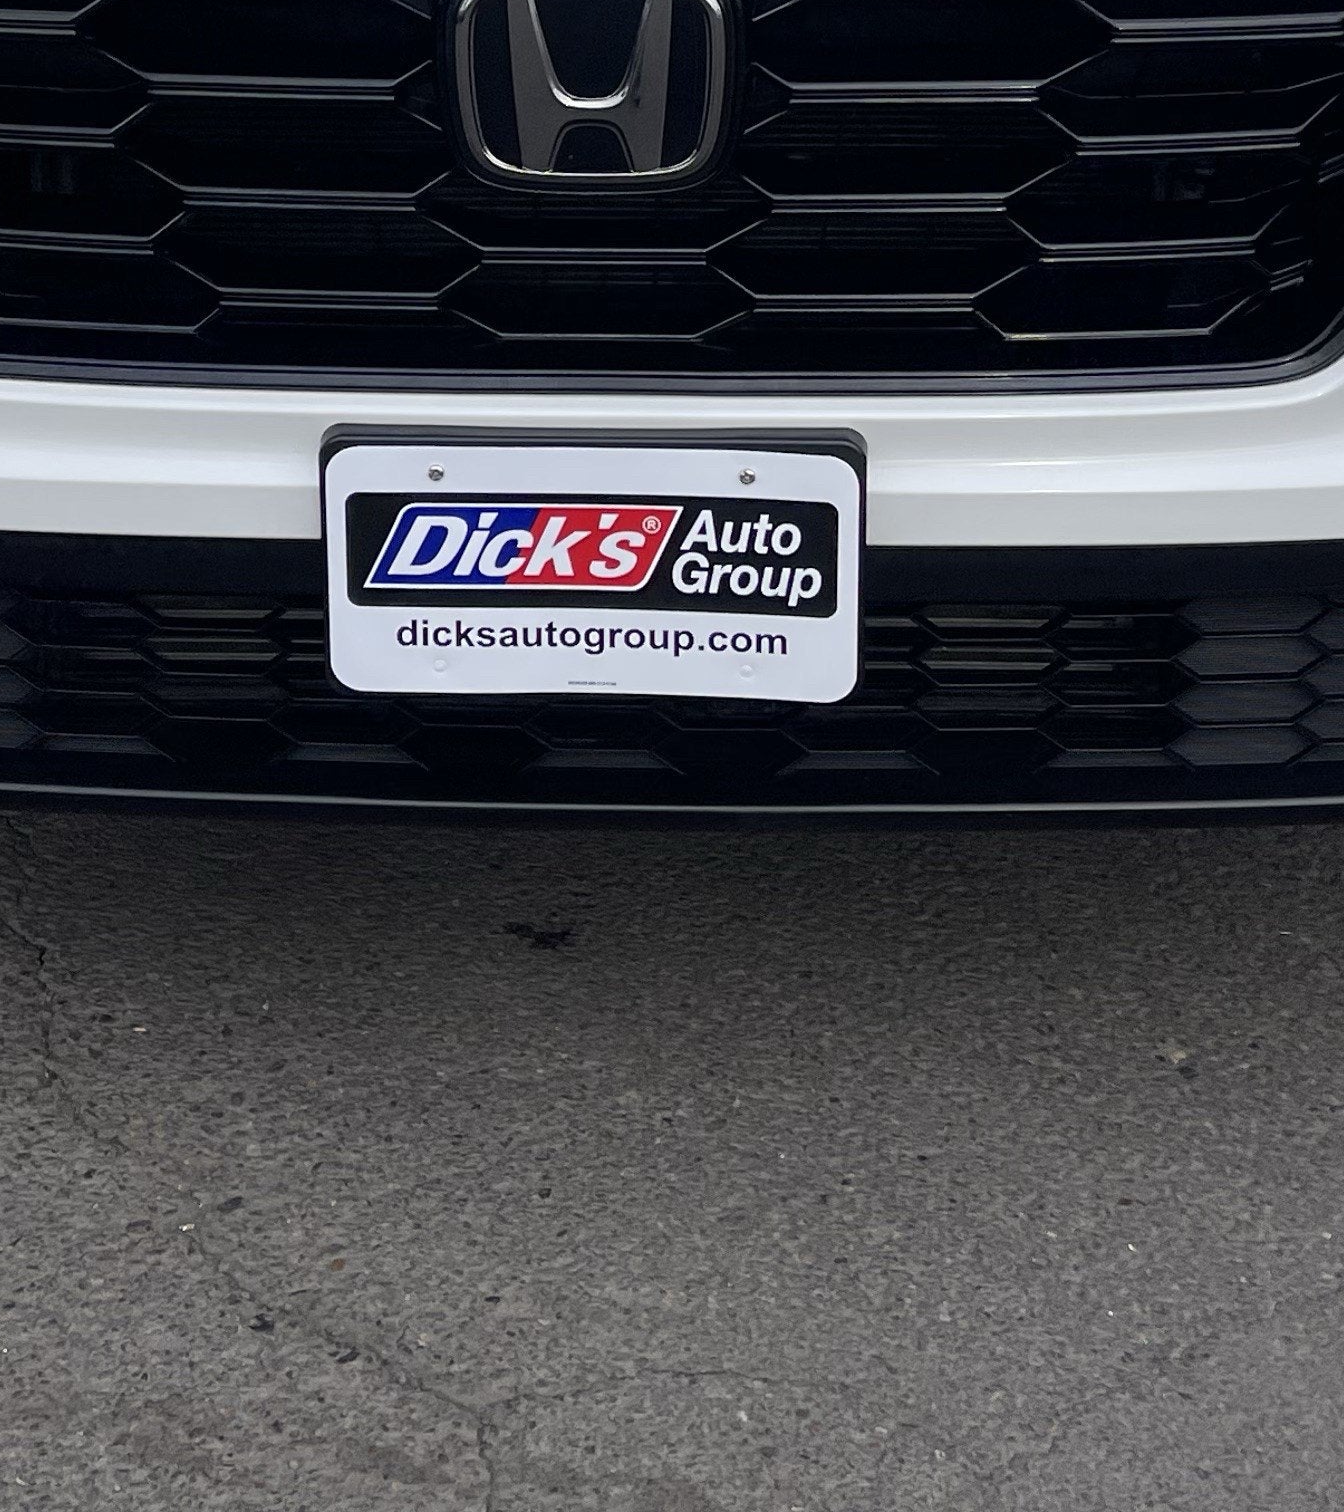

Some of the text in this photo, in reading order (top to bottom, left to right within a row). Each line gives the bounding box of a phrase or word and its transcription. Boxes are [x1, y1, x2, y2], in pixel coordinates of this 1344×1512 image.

[680, 510, 801, 555] Auto
[672, 553, 822, 606] Group
[396, 620, 788, 655] dicksautogroup.com
